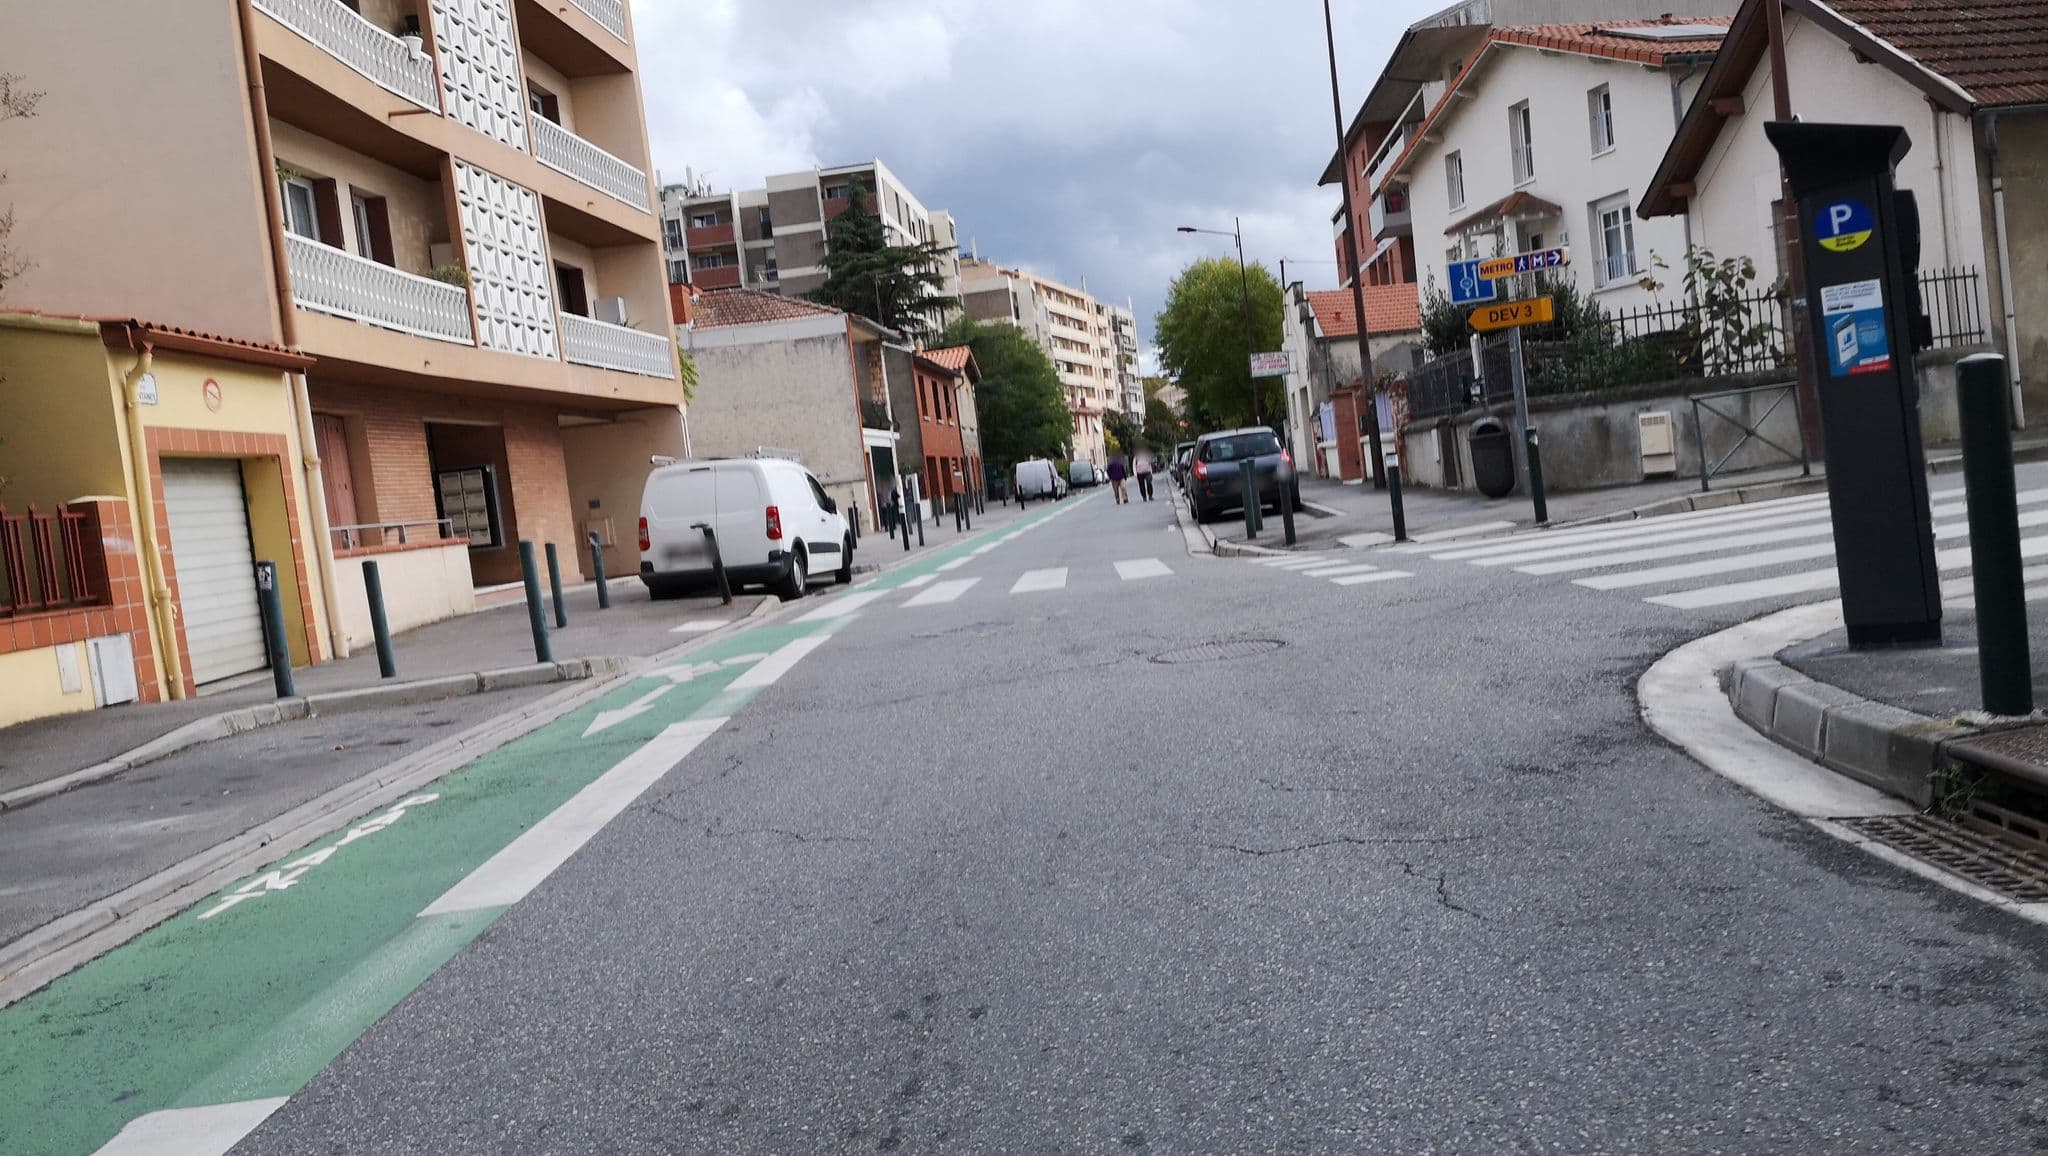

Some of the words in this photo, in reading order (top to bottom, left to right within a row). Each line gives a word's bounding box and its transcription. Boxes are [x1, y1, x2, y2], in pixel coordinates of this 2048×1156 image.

[1830, 204, 1852, 235] P
[1488, 307, 1519, 323] DEV
[1524, 305, 1533, 318] 3
